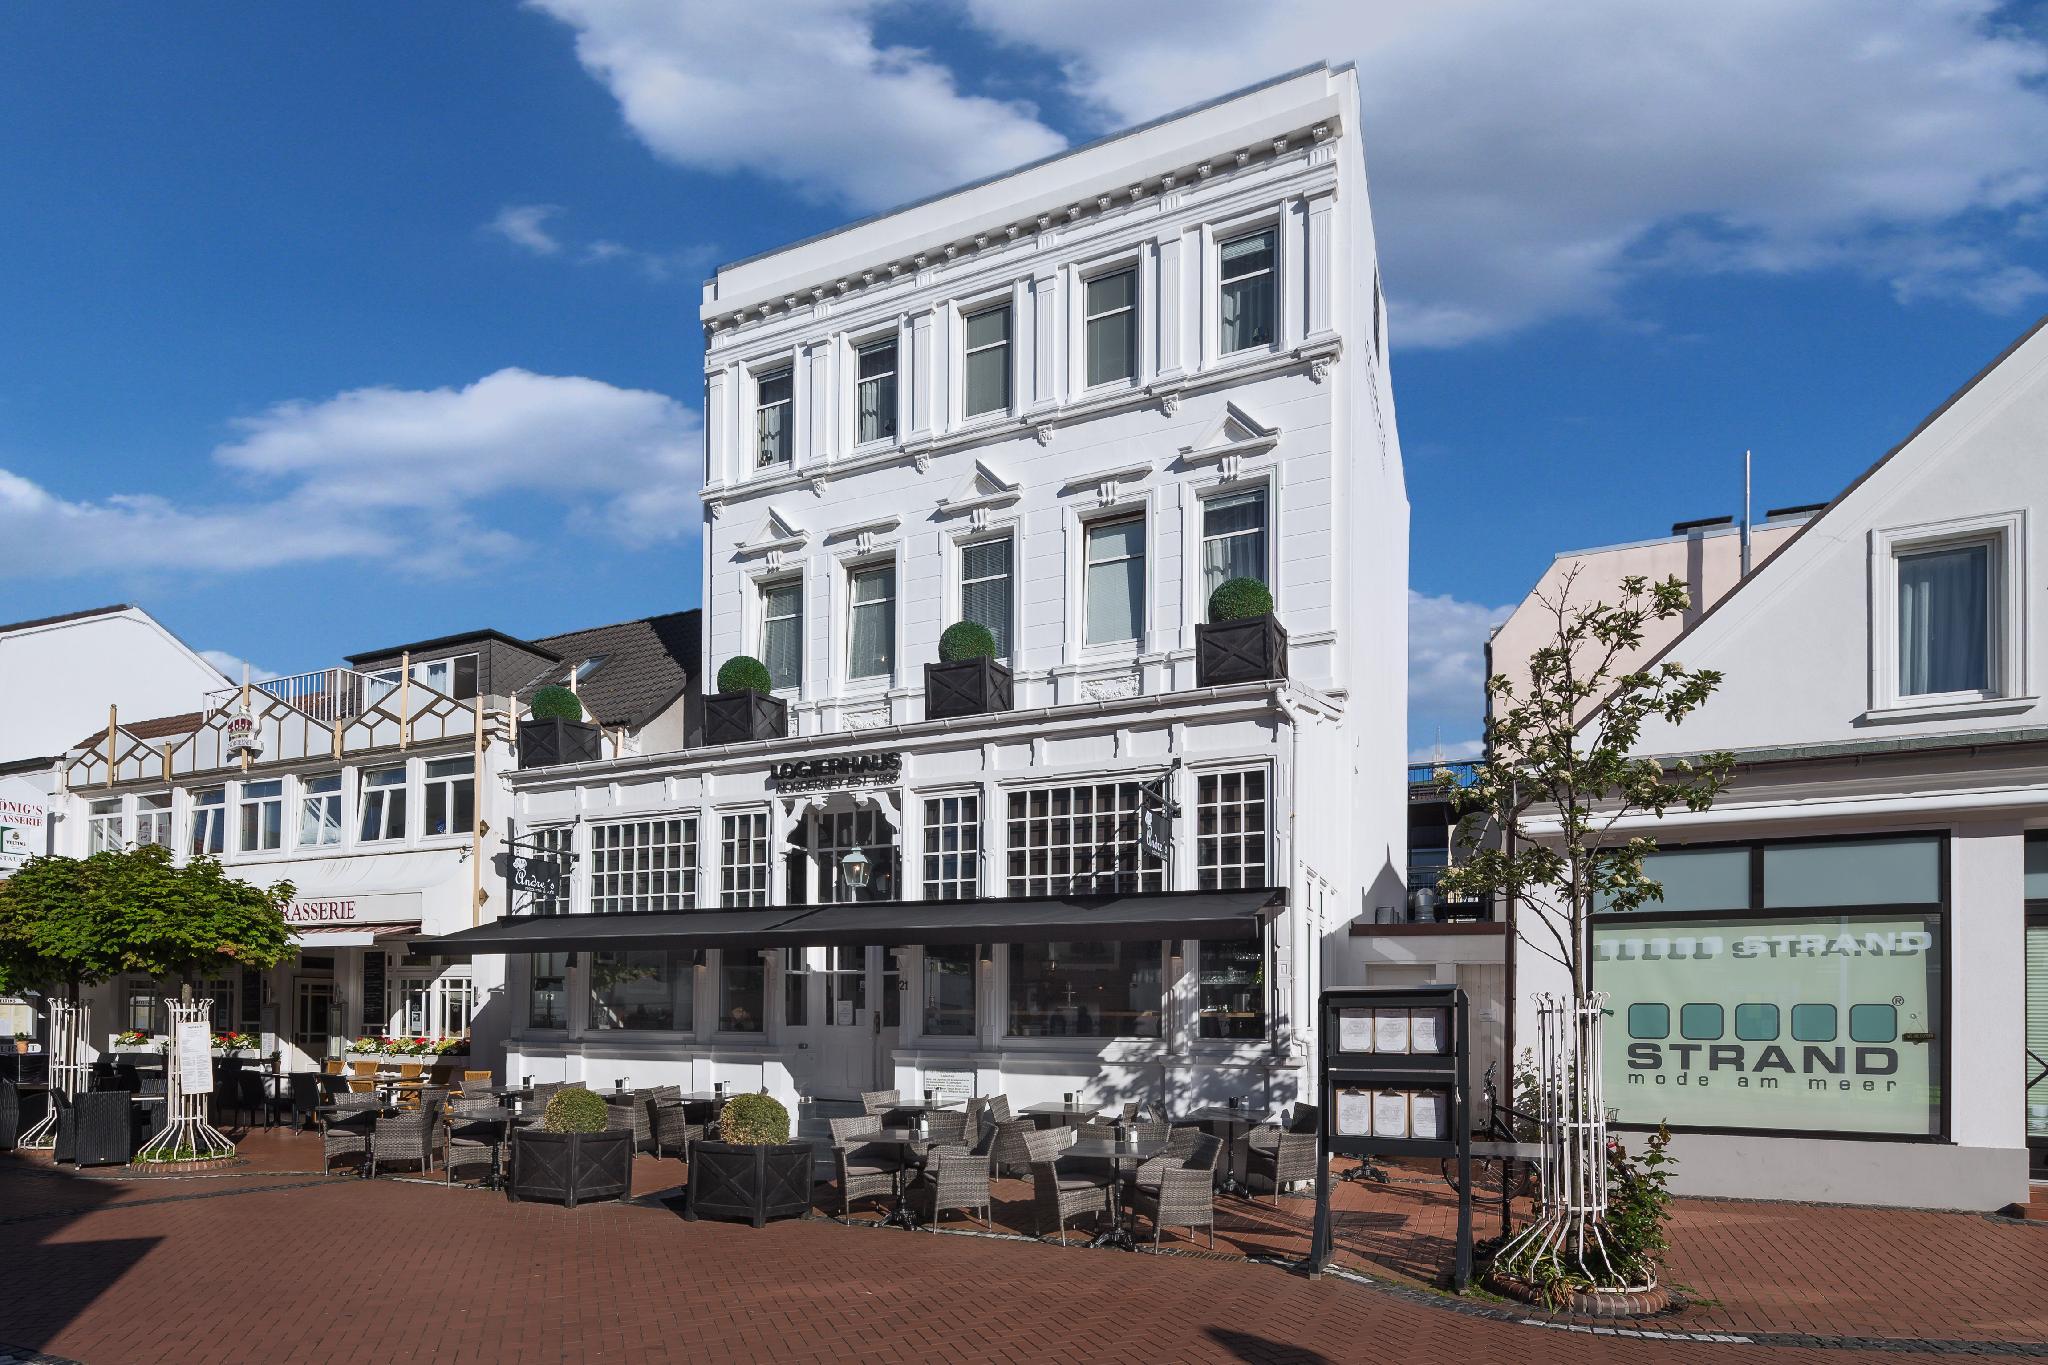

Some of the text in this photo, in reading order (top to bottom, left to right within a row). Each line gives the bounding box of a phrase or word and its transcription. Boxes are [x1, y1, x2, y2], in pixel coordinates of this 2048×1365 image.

[274, 901, 356, 921] RASSERIE
[899, 980, 909, 991] 21
[1627, 1043, 1899, 1076] STRAND
[1628, 1071, 1897, 1092] mode am meer
